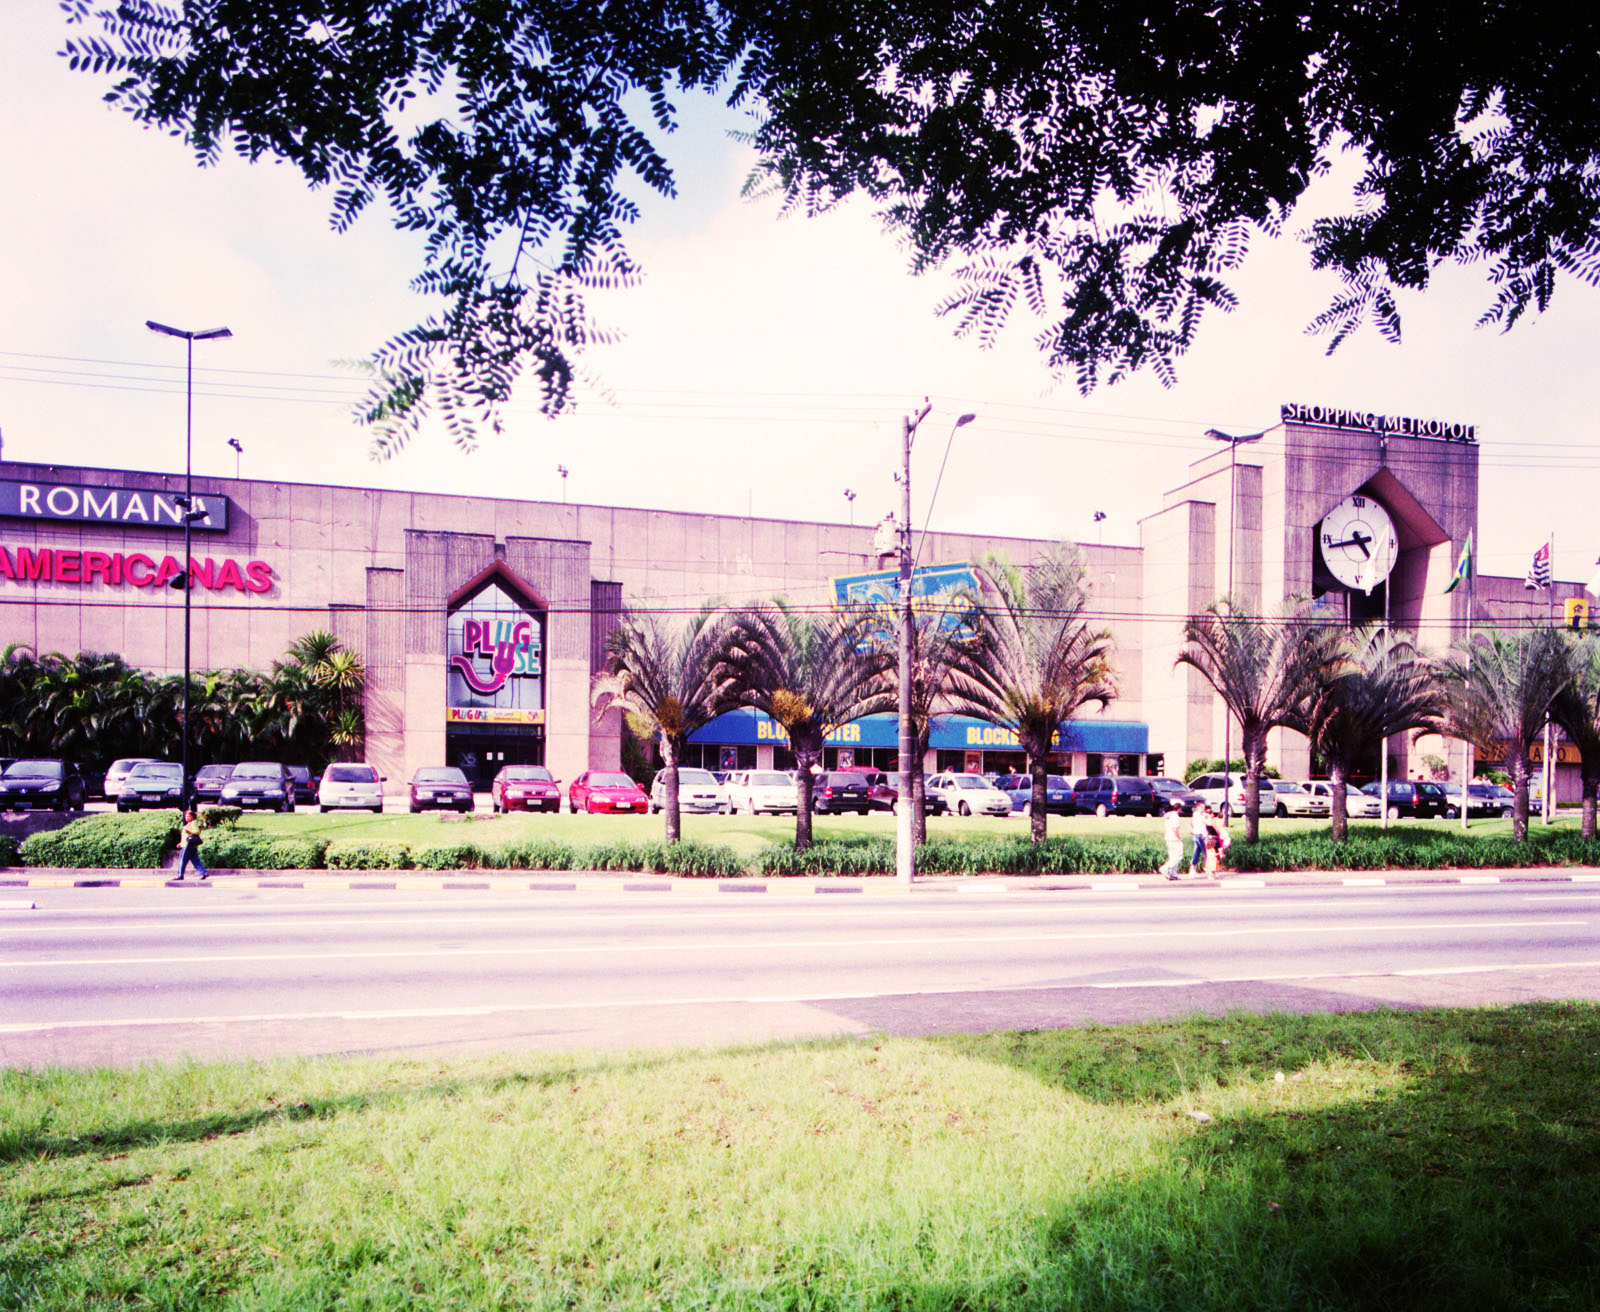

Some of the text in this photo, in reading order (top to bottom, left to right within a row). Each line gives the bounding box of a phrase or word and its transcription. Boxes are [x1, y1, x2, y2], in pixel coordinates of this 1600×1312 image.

[1283, 403, 1377, 429] SHOPPING
[466, 620, 531, 653] PLUG
[494, 641, 540, 674] USE
